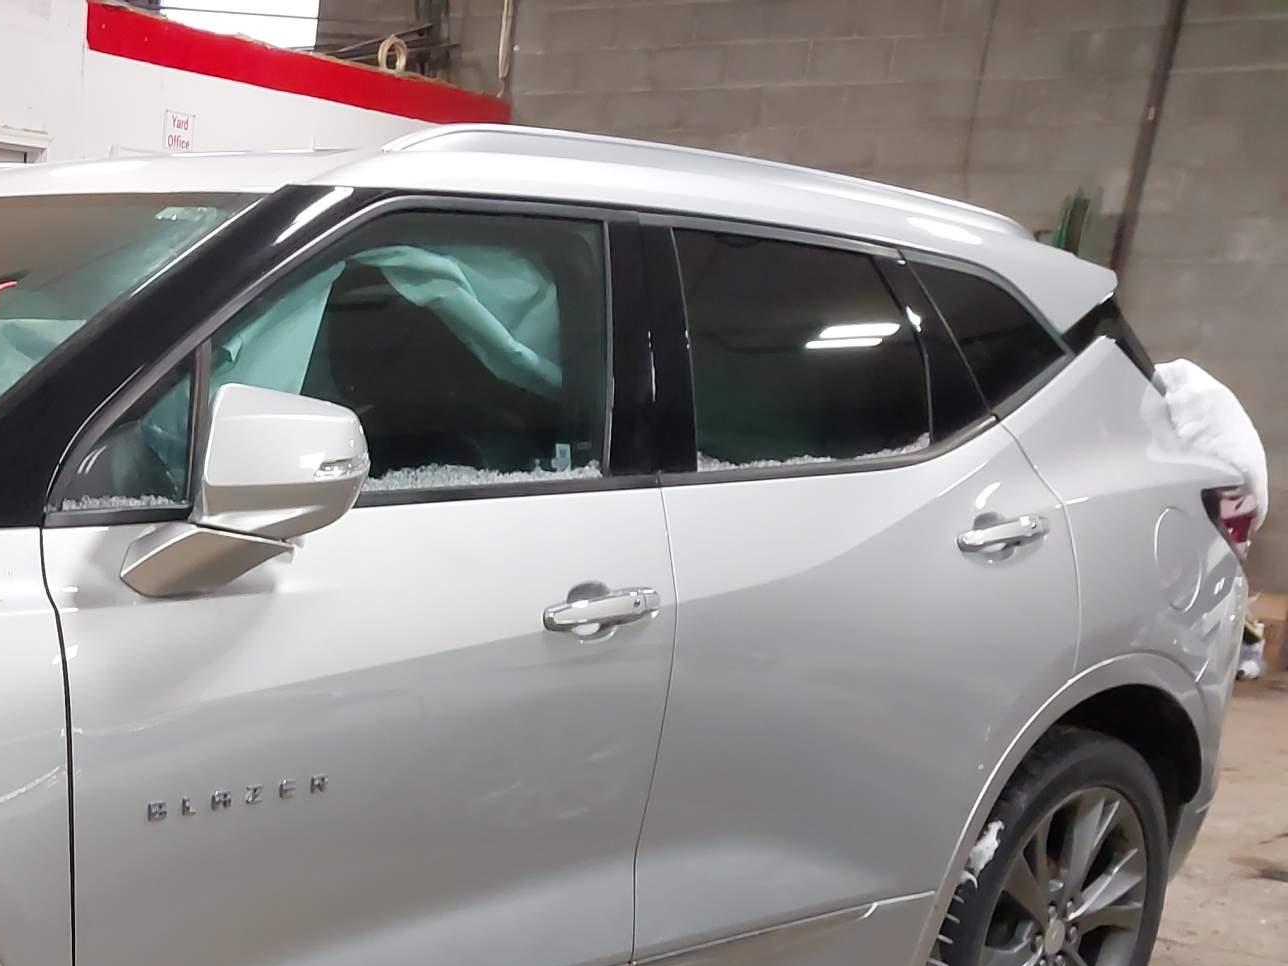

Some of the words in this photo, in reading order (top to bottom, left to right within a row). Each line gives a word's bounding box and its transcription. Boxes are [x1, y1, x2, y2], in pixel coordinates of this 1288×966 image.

[172, 113, 189, 130] Yard
[167, 134, 190, 150] Office
[147, 774, 329, 822] BLAZER
